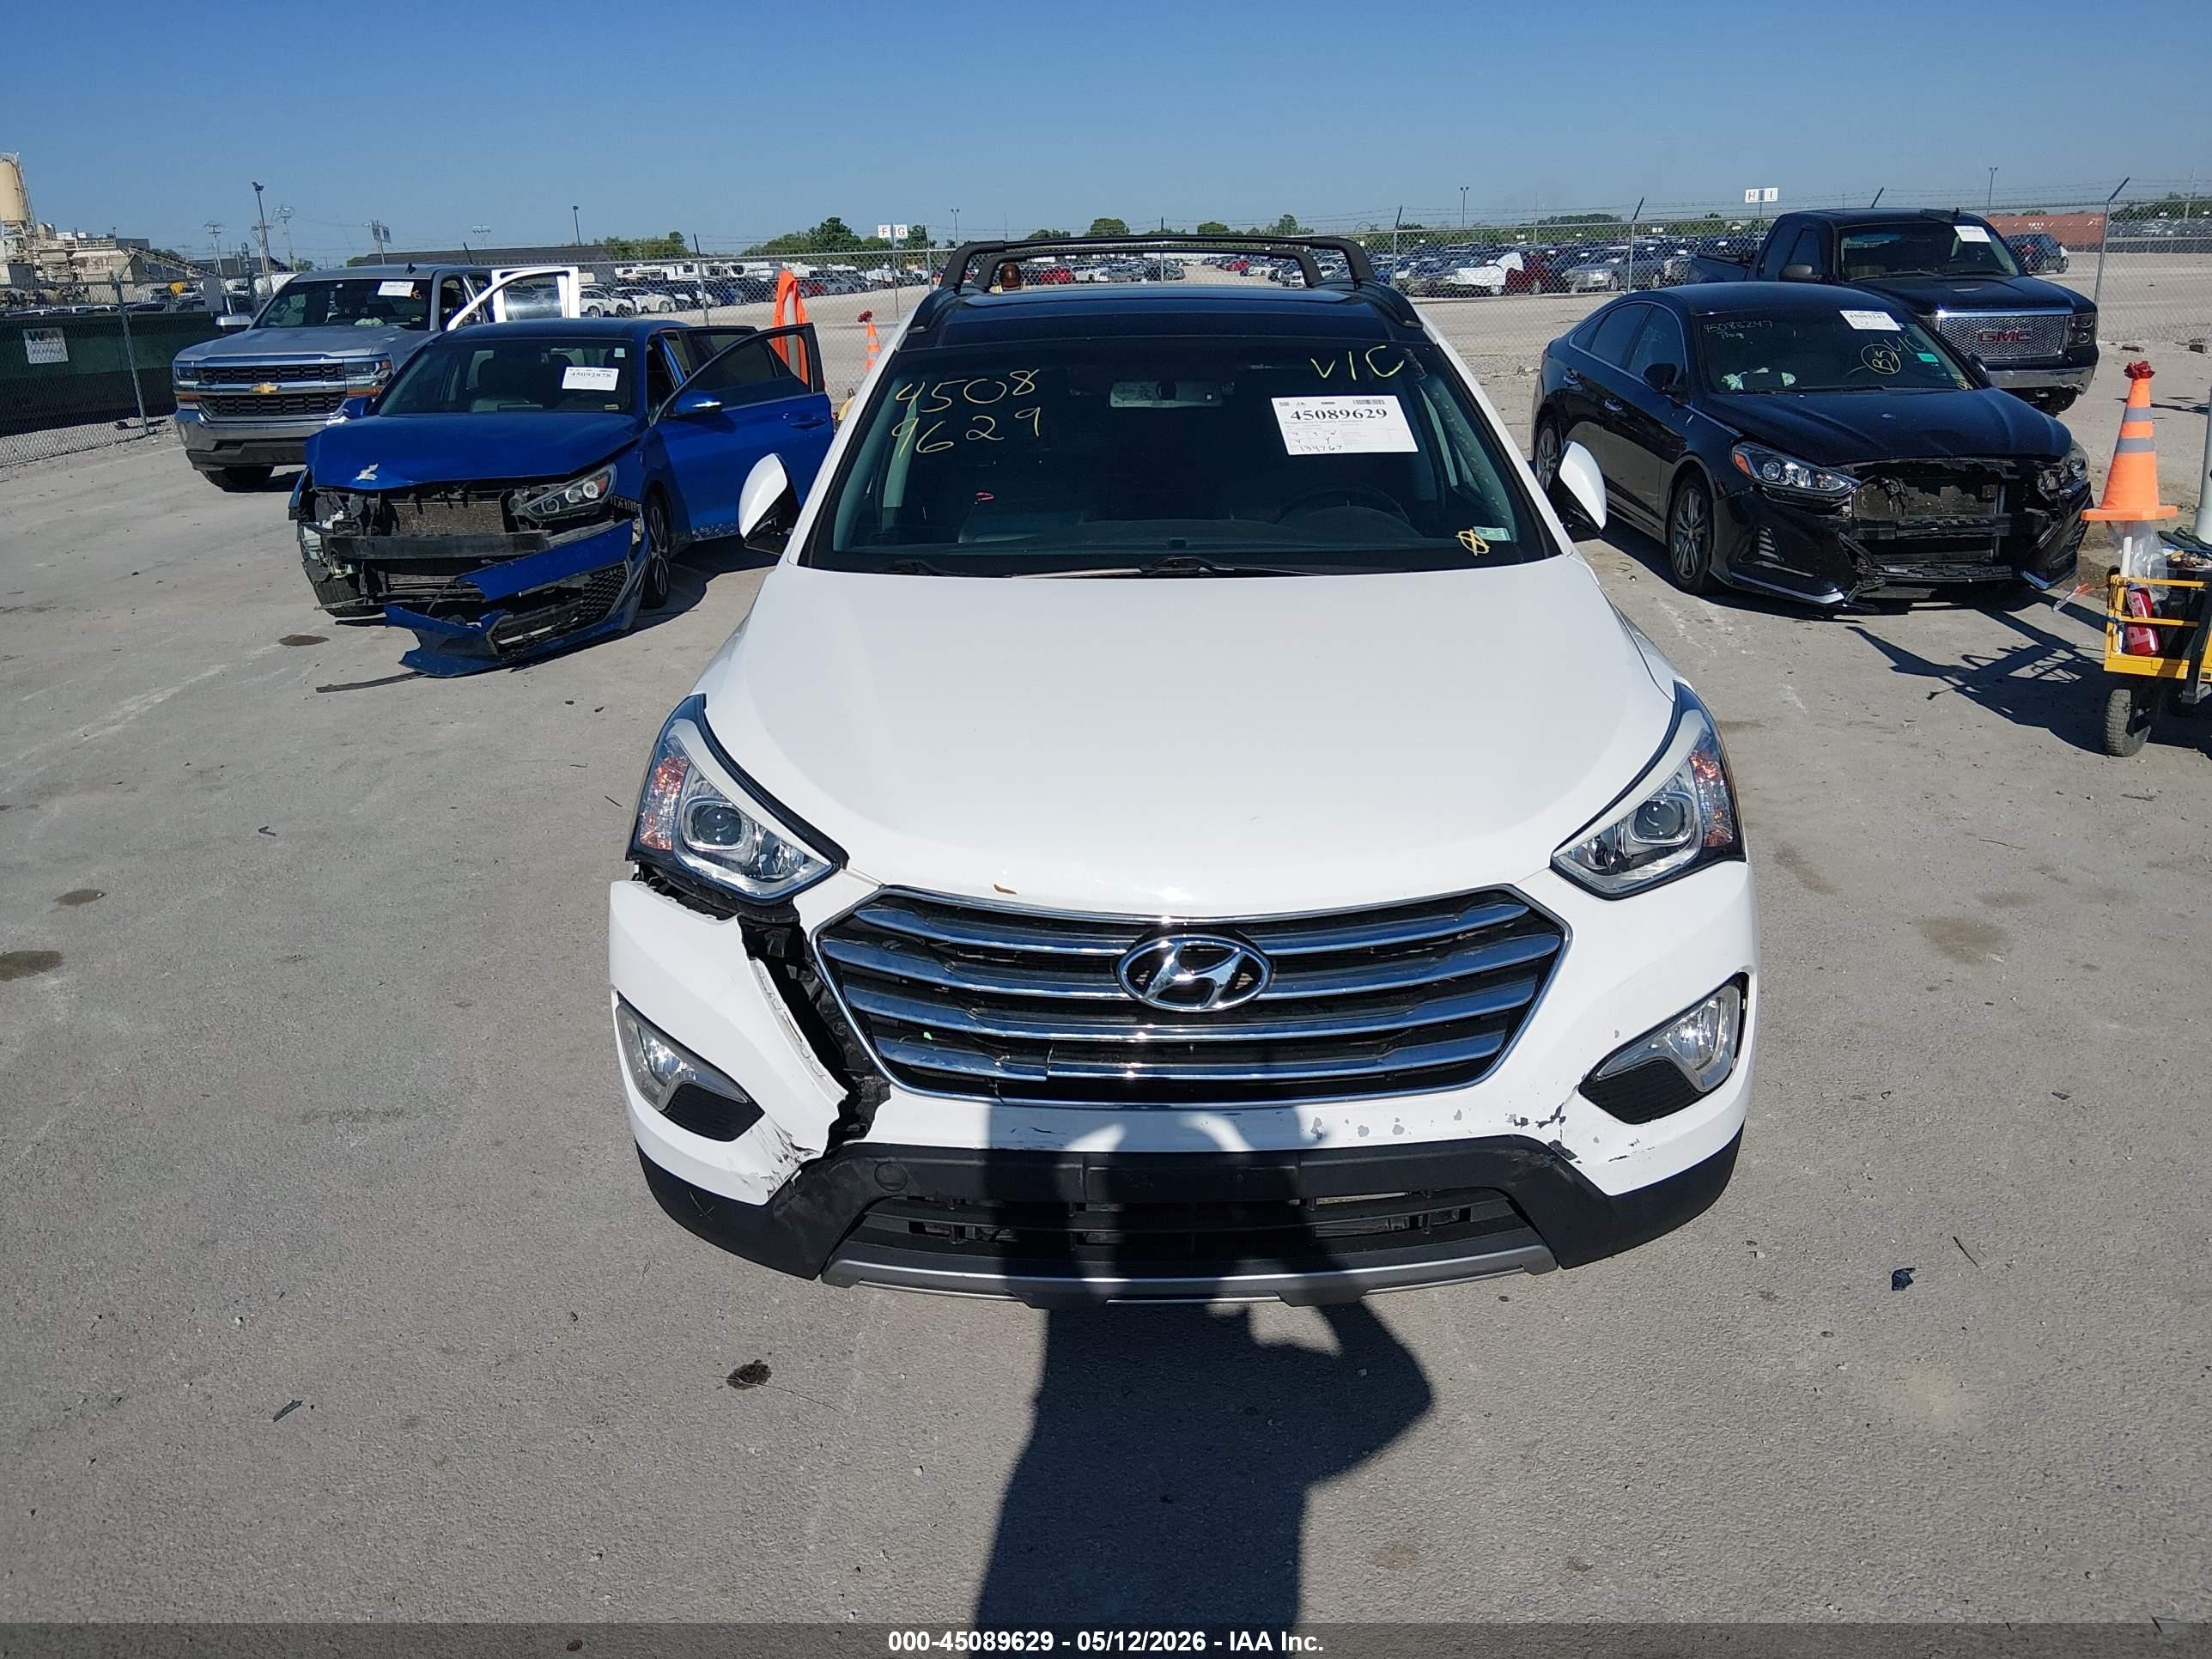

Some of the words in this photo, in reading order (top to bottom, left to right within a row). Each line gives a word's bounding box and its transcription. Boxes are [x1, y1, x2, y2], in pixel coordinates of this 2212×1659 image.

[1748, 191, 1755, 200] H
[881, 227, 888, 236] F
[897, 227, 905, 236] G
[1978, 330, 2033, 343] GMC
[1310, 345, 1405, 380] VIC
[895, 368, 1040, 412] 4508
[1291, 408, 1388, 421] 45089629
[891, 406, 1041, 459] 9629
